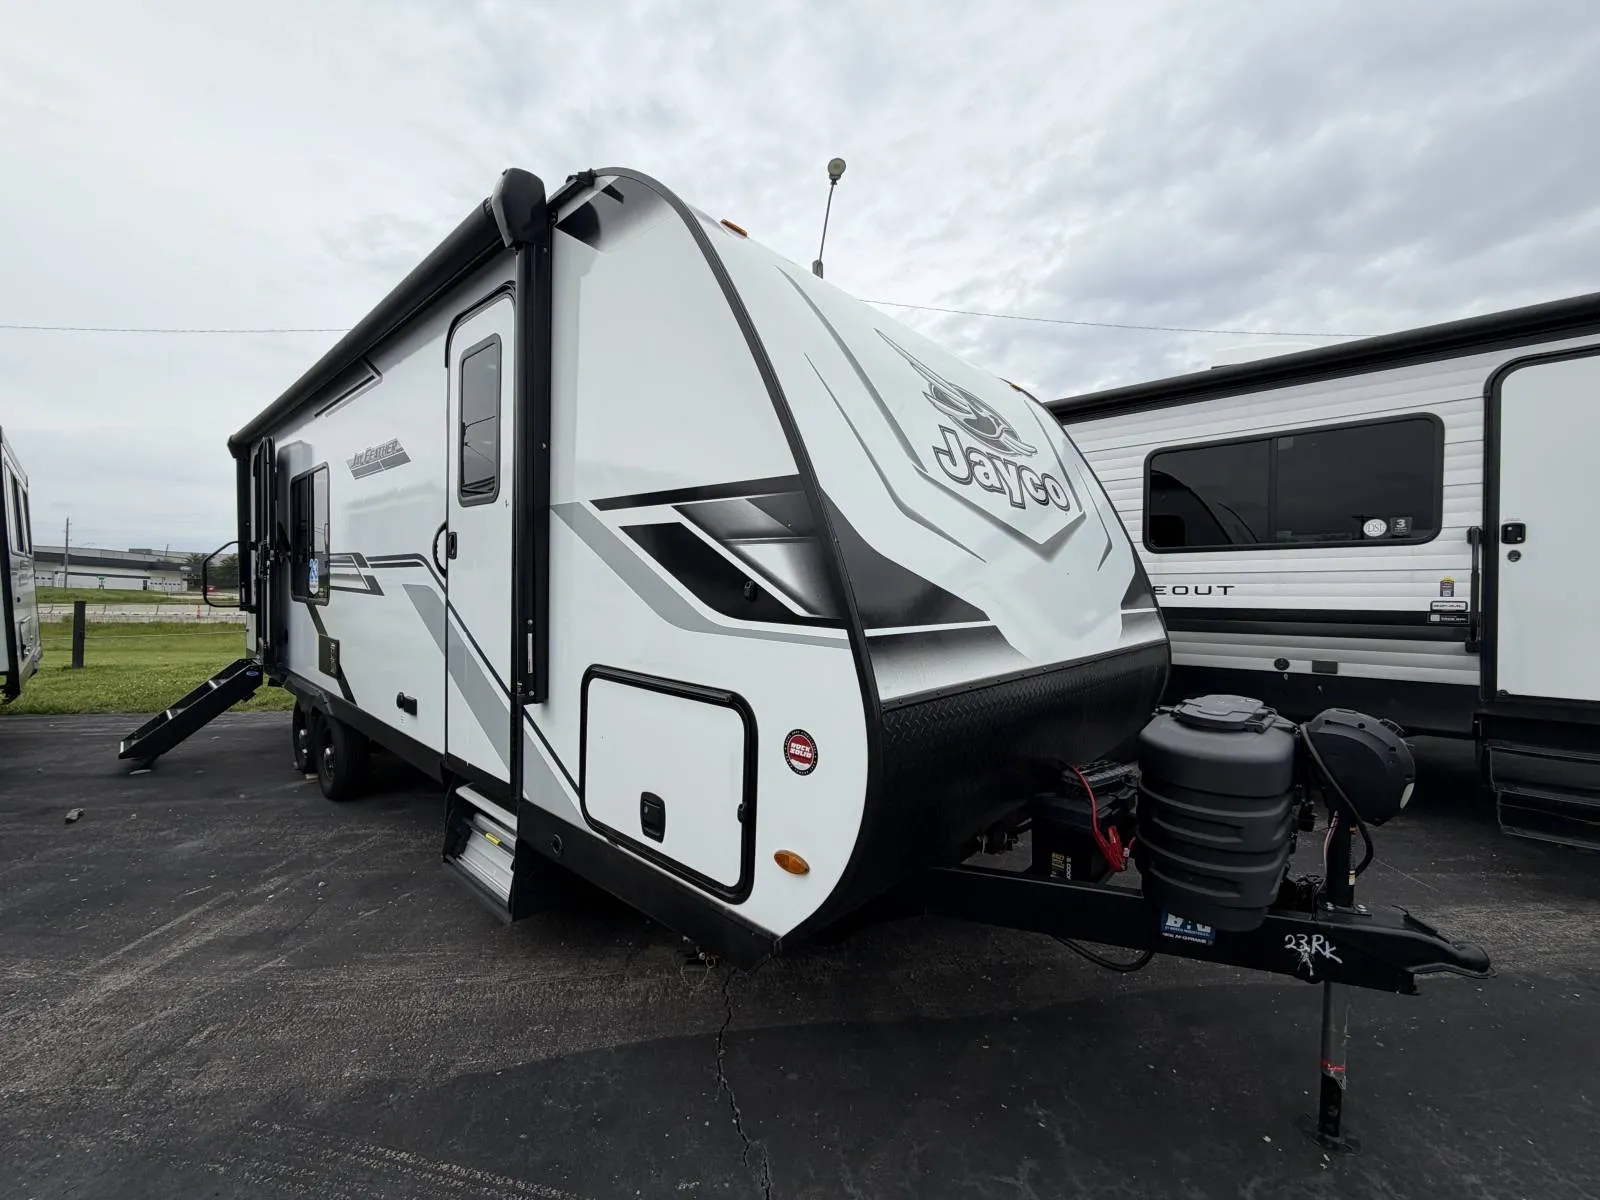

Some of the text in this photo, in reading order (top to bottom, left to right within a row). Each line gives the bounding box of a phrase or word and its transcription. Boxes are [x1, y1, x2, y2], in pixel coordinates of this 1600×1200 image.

[932, 424, 1070, 511] Jayco
[1396, 519, 1406, 528] 3
[790, 742, 811, 752] ROCK
[789, 748, 812, 759] SOLID
